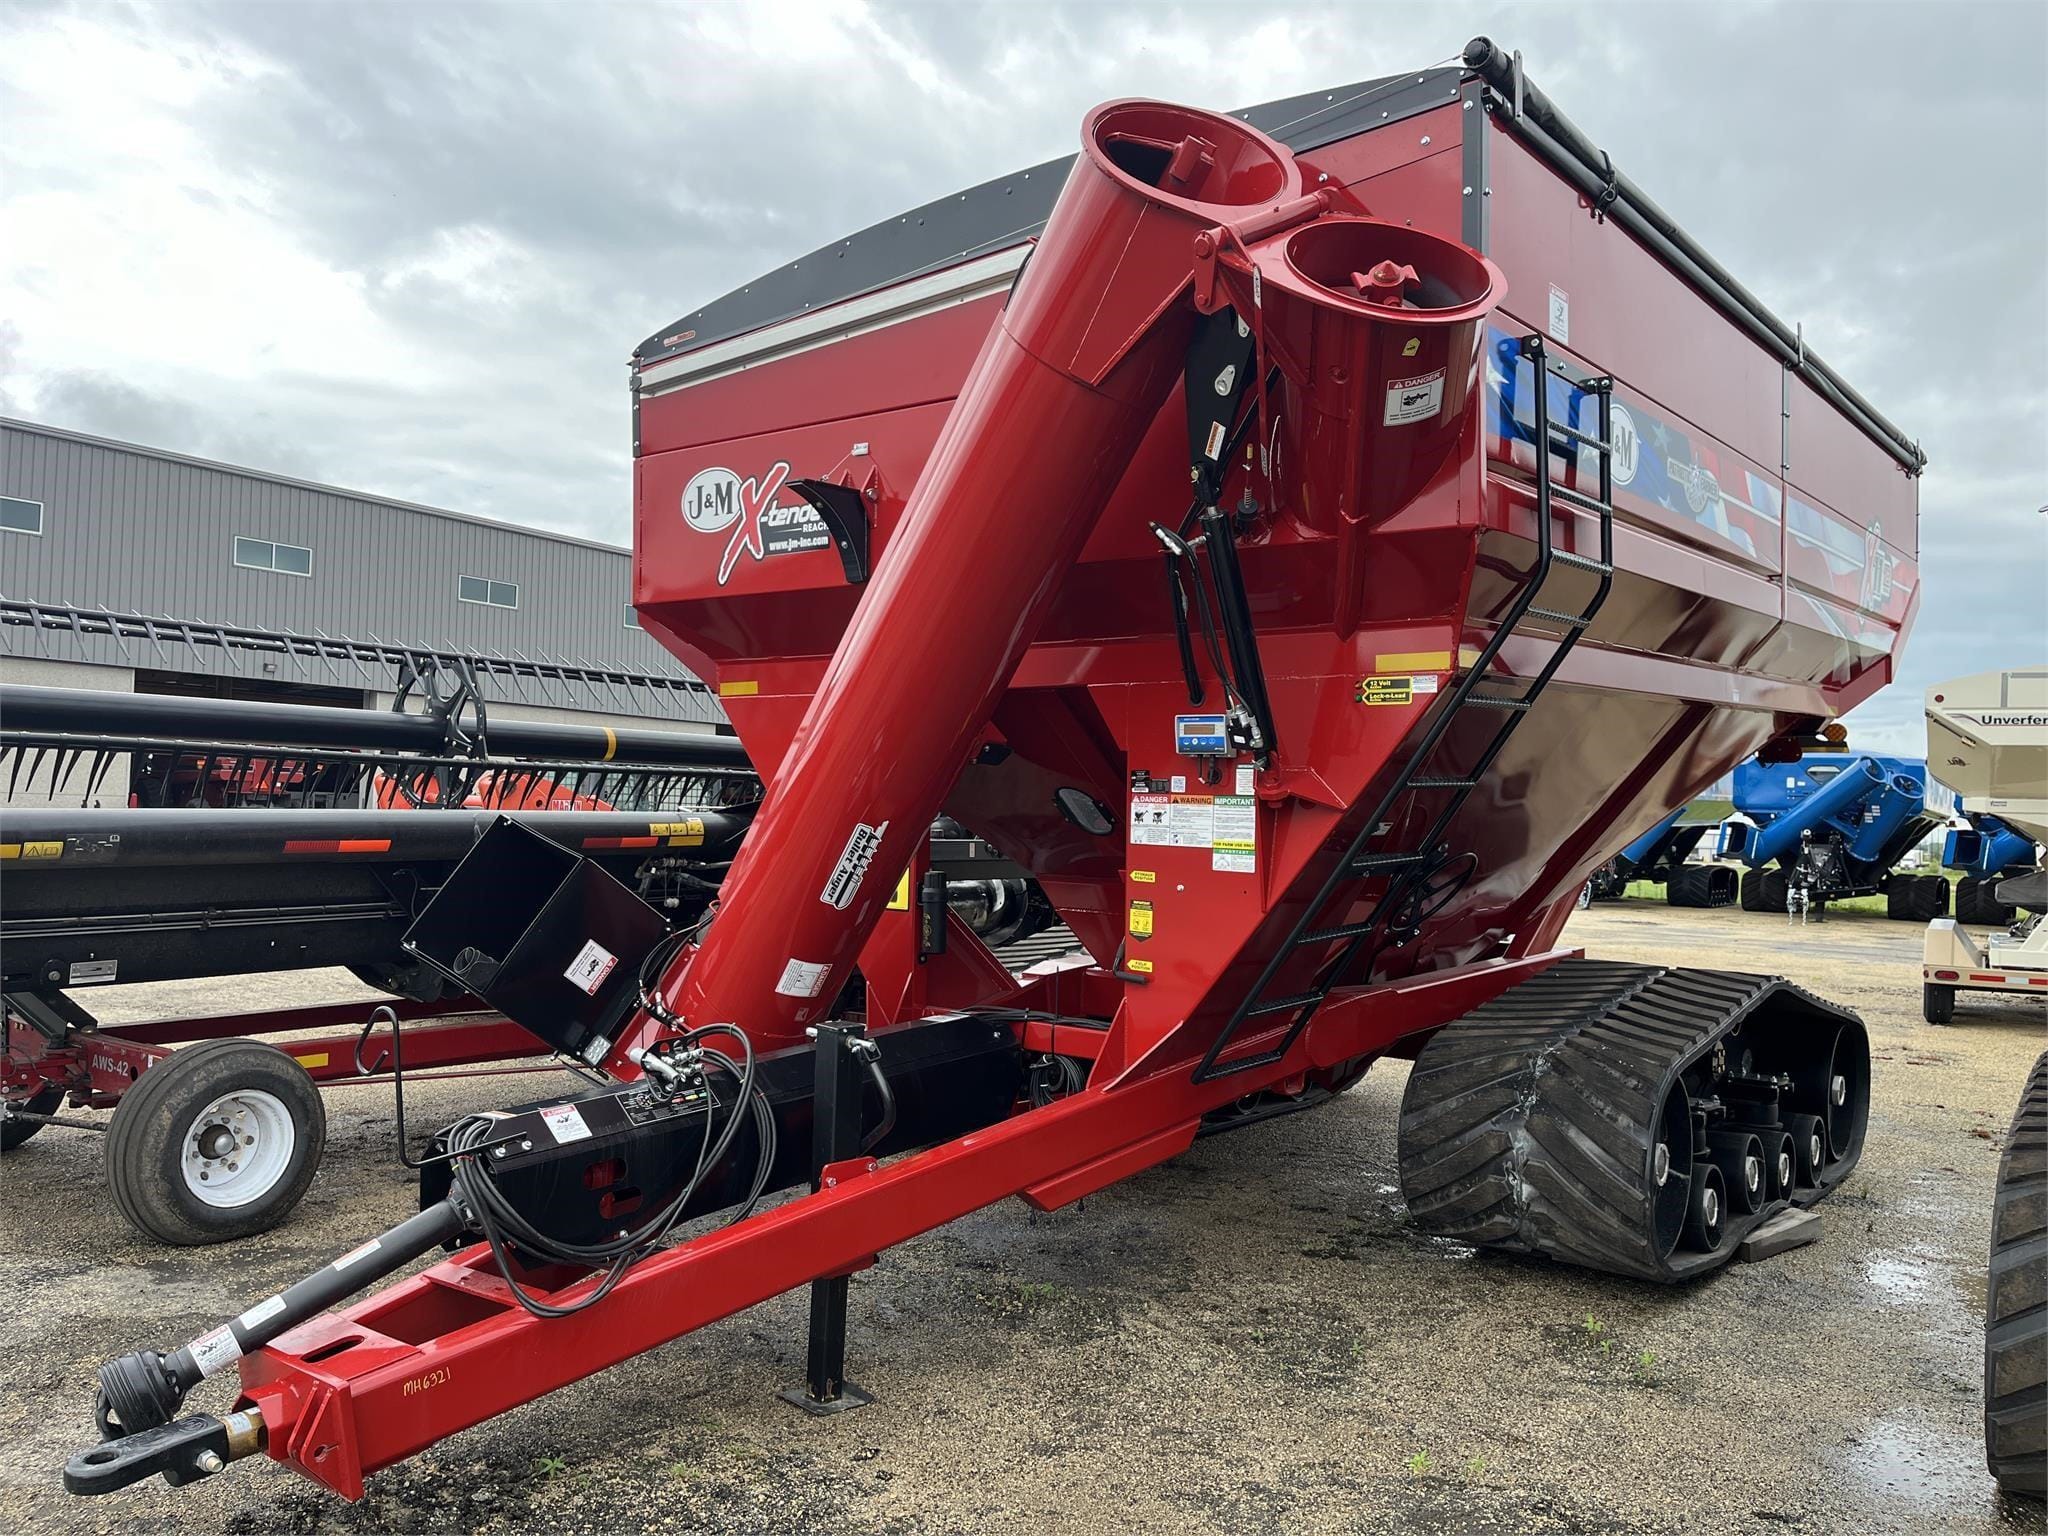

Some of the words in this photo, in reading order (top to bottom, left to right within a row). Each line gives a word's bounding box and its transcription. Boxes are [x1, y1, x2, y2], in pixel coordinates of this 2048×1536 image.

[1404, 372, 1441, 387] DANGER
[688, 481, 735, 519] J&M
[717, 460, 821, 585] X-tende
[769, 536, 829, 551] www.jm-inc.com
[552, 799, 582, 811] MARIN
[846, 829, 868, 864] Bullet
[827, 865, 849, 900] Auger
[590, 966, 610, 991] DANGER
[92, 1054, 128, 1076] AWS-42
[404, 1366, 450, 1397] MH6321
